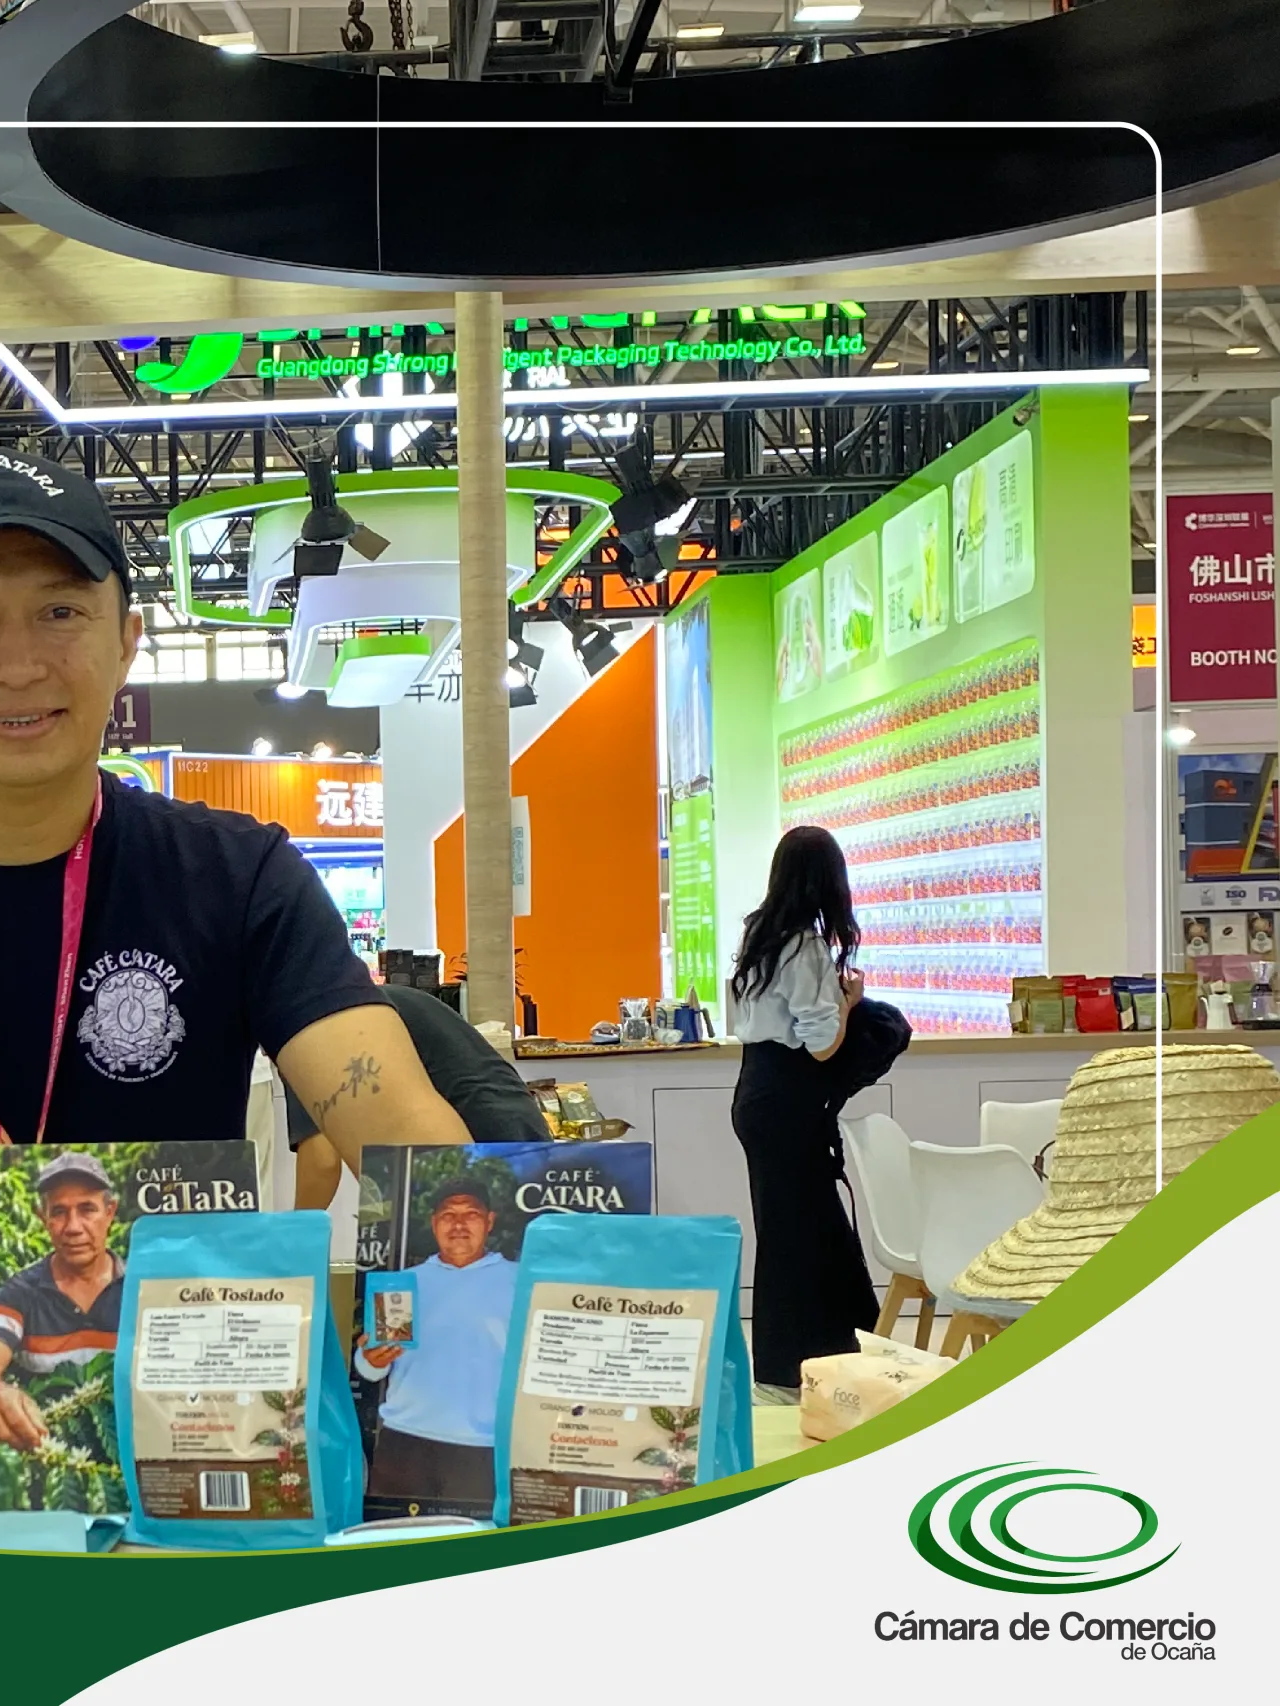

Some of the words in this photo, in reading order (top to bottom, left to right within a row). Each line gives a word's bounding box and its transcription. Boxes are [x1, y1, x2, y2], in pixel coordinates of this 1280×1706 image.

[256, 356, 369, 380] Guangdong
[556, 343, 661, 369] Packaging
[664, 339, 781, 364] Technology
[824, 333, 867, 356] Ltd.
[1189, 591, 1250, 604] FOSHANSHI
[1190, 650, 1250, 667] BOOTH
[177, 761, 209, 773] 11C22
[80, 951, 118, 992] CAFÉ
[119, 949, 184, 993] CATARA
[136, 1164, 182, 1182] CAFÉ
[545, 1167, 594, 1182] CAFÉ
[515, 1182, 625, 1213] CATARA
[179, 1287, 215, 1302] Café
[219, 1287, 285, 1302] Tostado
[572, 1294, 613, 1312] Café
[617, 1298, 684, 1315] Tostado
